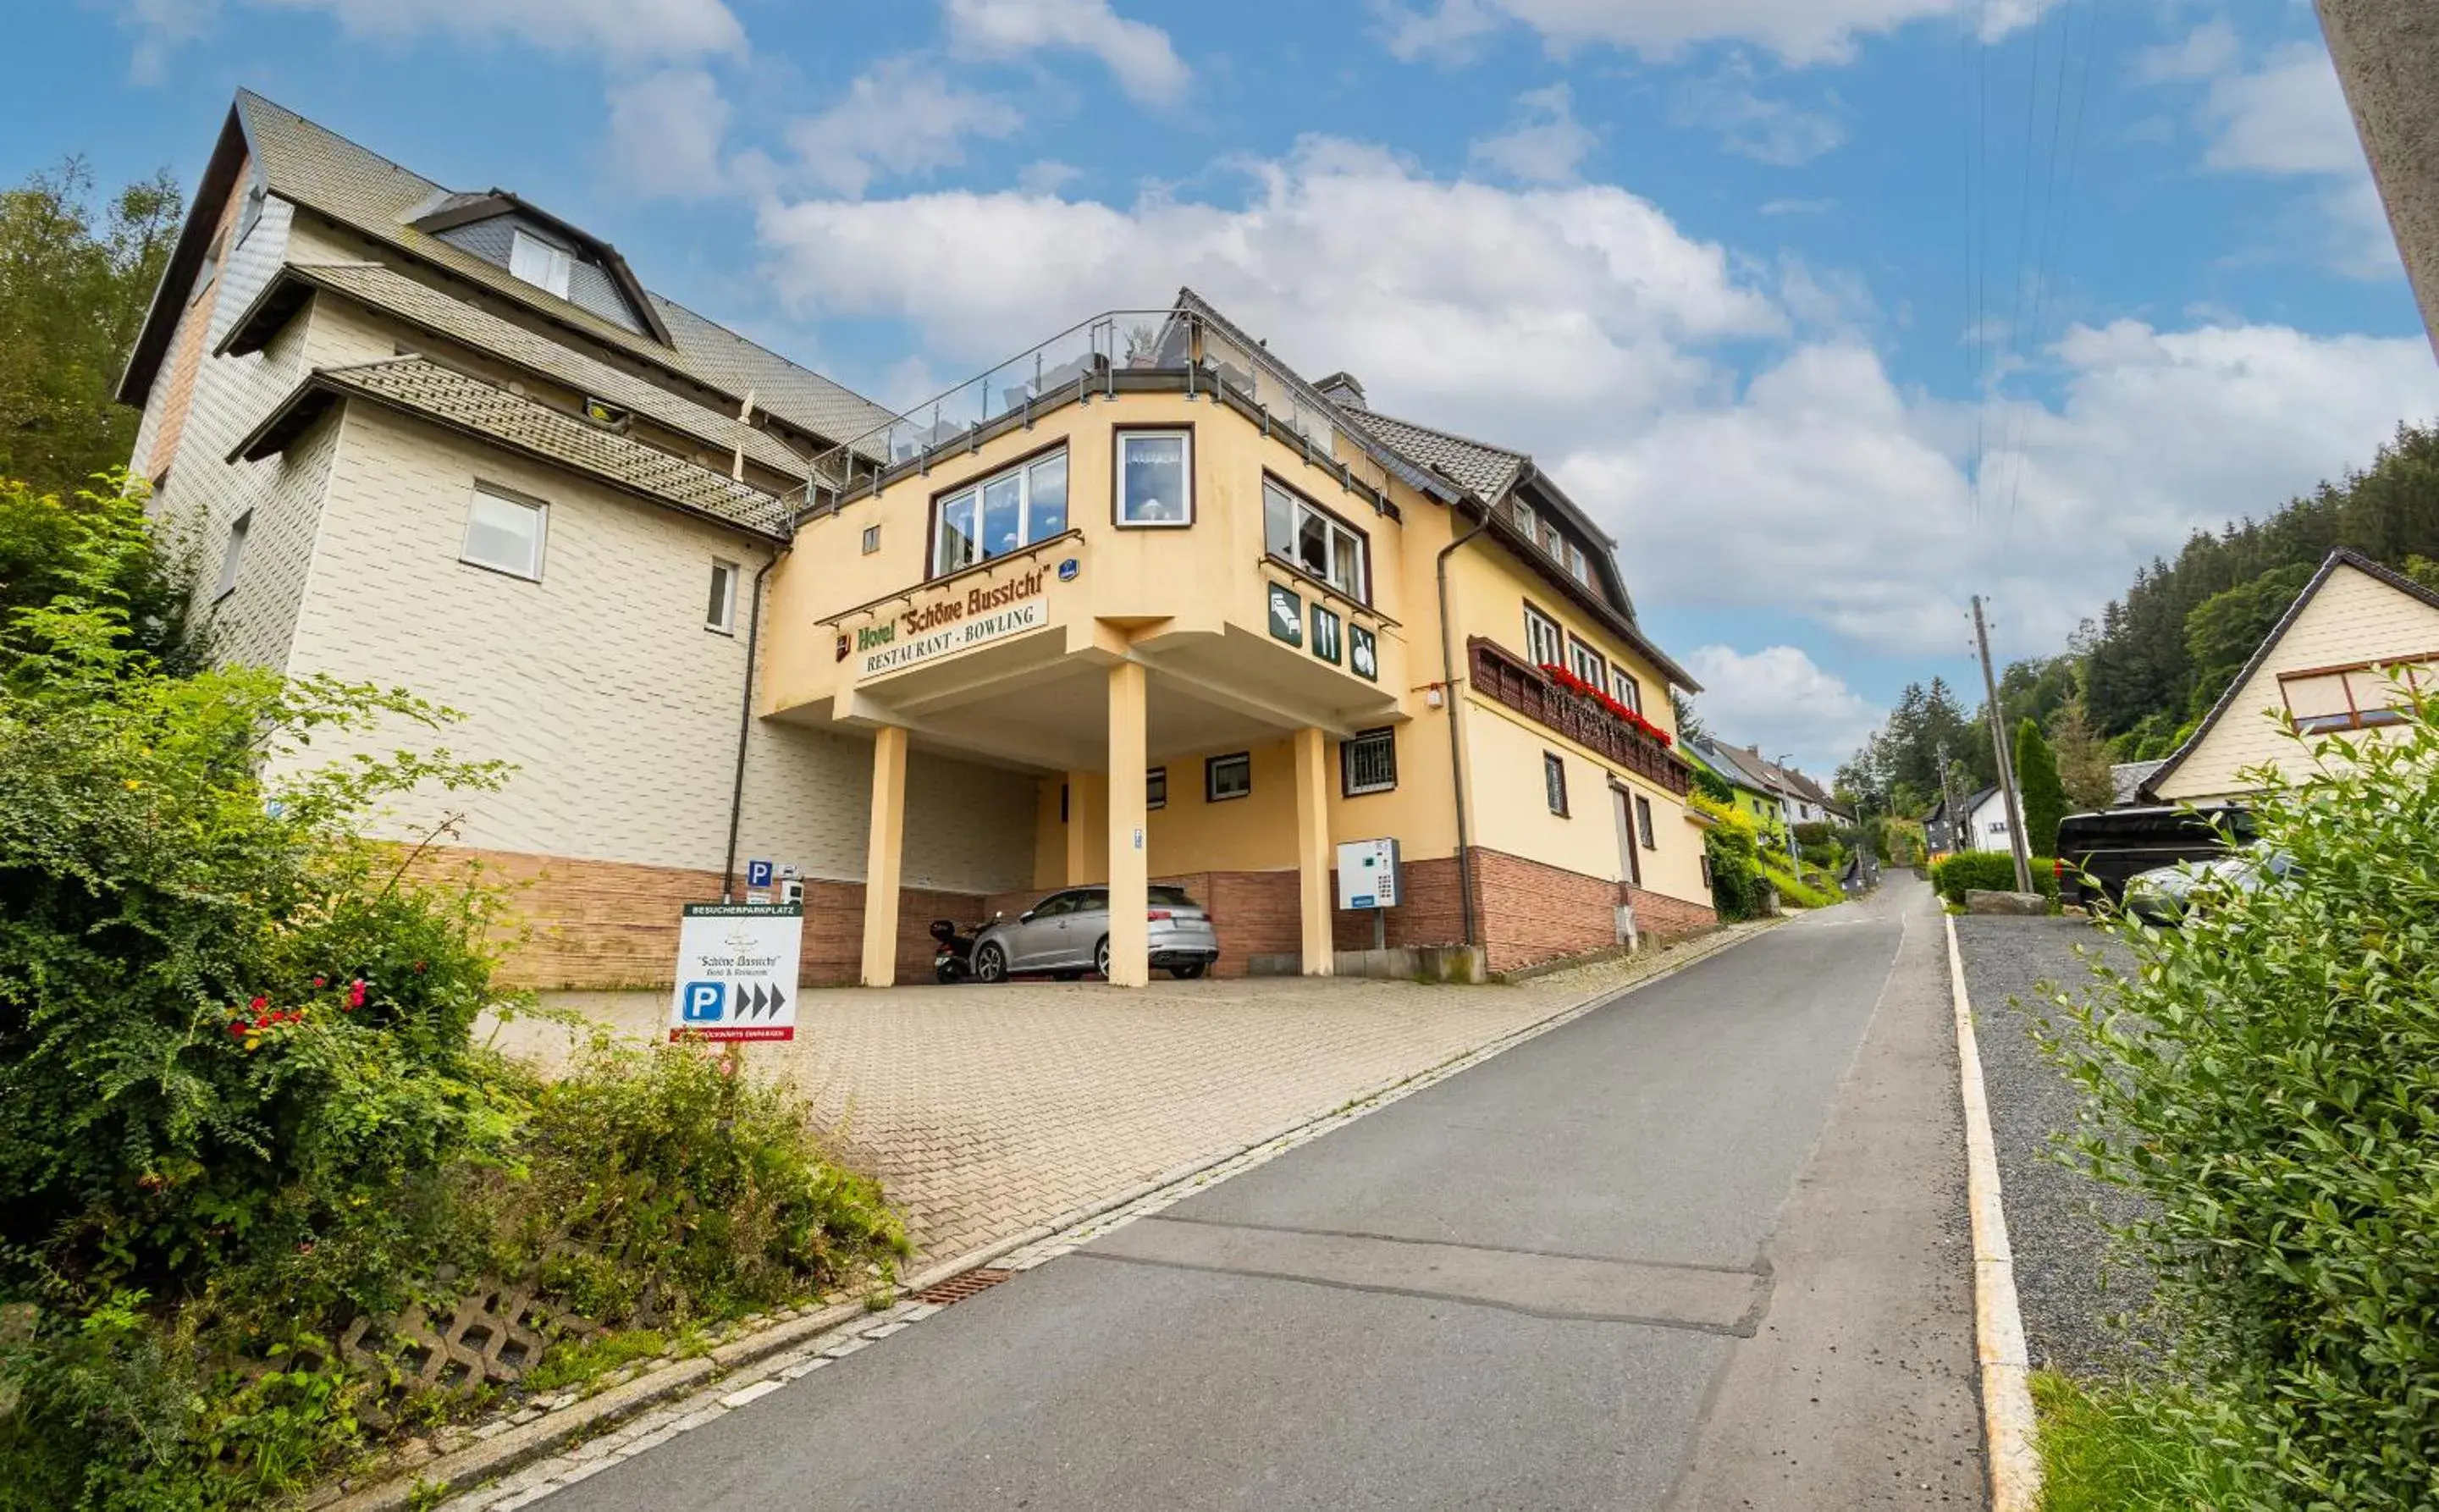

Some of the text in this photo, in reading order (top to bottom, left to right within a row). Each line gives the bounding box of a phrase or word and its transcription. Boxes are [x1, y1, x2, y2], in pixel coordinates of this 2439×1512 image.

[857, 618, 896, 652] Hotel
[867, 605, 1034, 672] RESTAURANT BOWLING
[752, 864, 768, 884] P
[692, 905, 795, 915] BESUCHERPARKPLATZ
[693, 987, 717, 1017] P
